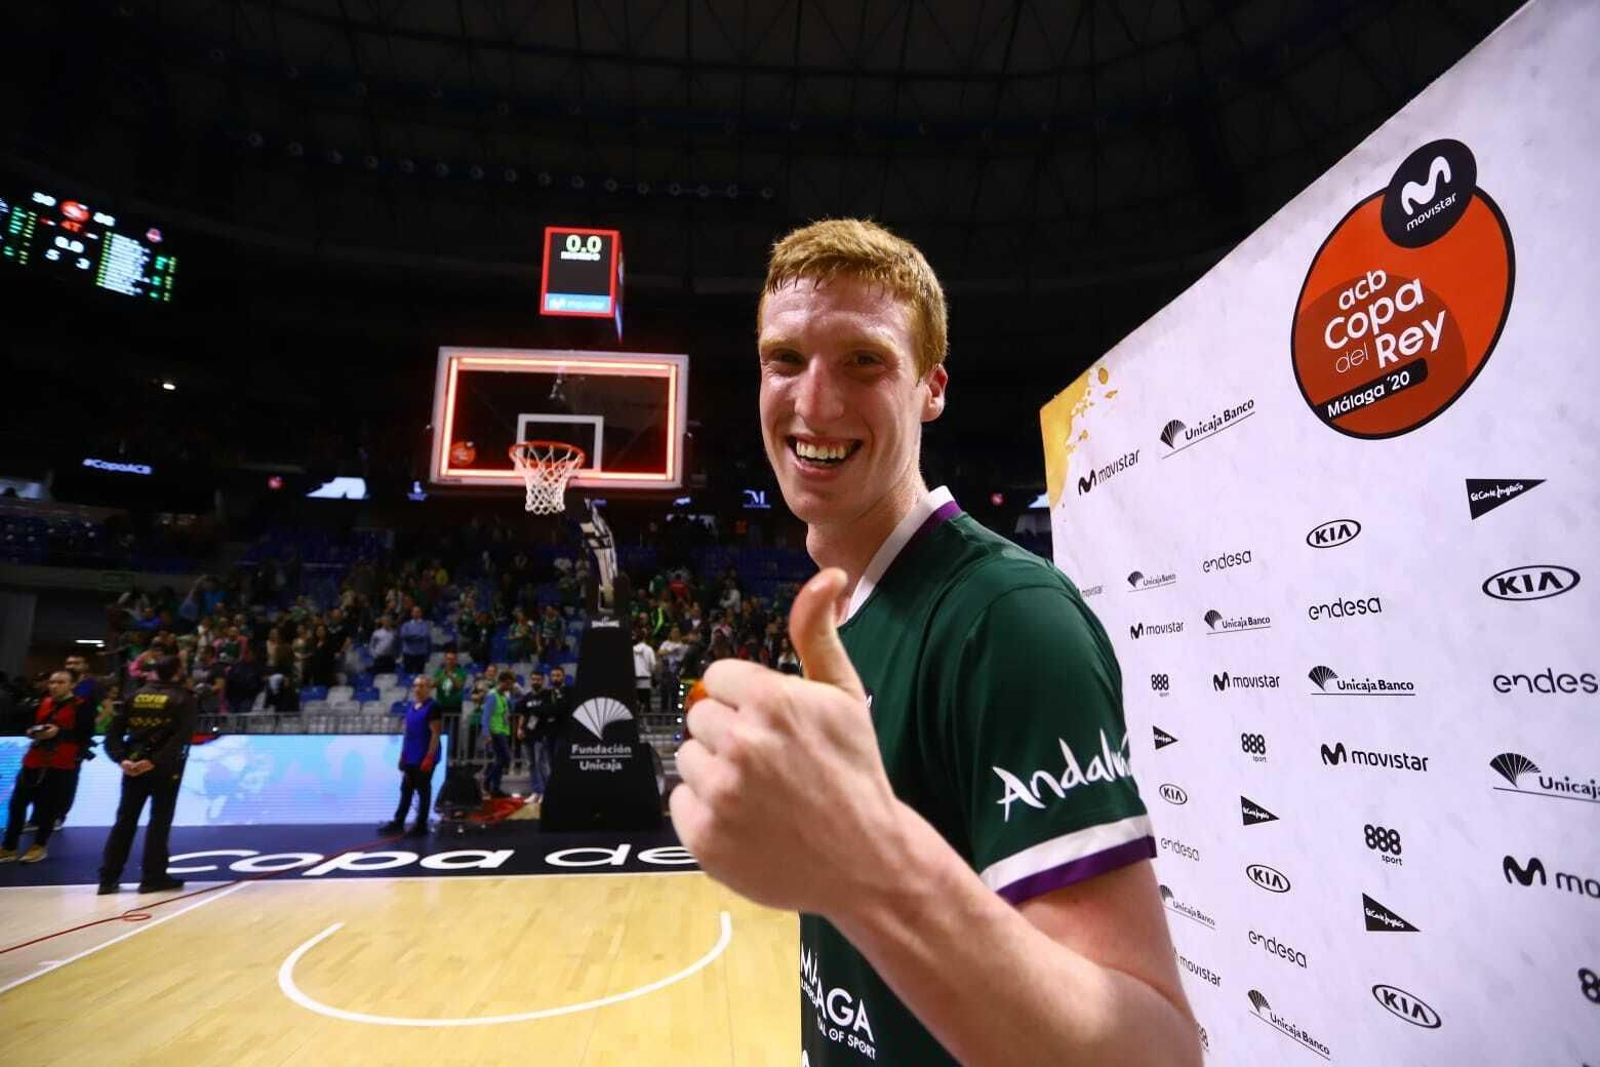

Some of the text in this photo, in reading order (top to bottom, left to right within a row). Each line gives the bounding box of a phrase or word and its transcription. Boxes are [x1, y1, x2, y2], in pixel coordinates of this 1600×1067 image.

[1405, 192, 1458, 231] movistar
[565, 234, 603, 253] 0.0
[1338, 269, 1387, 311] acb
[1335, 310, 1446, 374] del Rey
[1326, 383, 1386, 419] Málaga
[1184, 398, 1255, 442] Unicaja Banco
[1098, 449, 1140, 484] movistar
[1314, 524, 1352, 545] KIA
[1202, 549, 1252, 573] endesa
[1143, 572, 1177, 587] Unicaja Banco
[1496, 571, 1565, 596] KIA
[1308, 596, 1383, 621] endesa
[1145, 620, 1184, 636] movistar
[1221, 615, 1271, 630] Unicaja Banco
[1151, 673, 1169, 691] 888
[1232, 674, 1281, 690] movistar
[1336, 678, 1415, 693] Unicaja Banco
[1492, 667, 1599, 694] endes
[571, 743, 632, 755] Fundación
[1241, 733, 1266, 755] 888
[579, 758, 623, 773] Unicaja
[1351, 749, 1429, 772] movistar
[1163, 787, 1184, 802] KIA
[1160, 837, 1200, 861] endesa
[1363, 824, 1402, 855] 888
[1381, 854, 1403, 867] sport
[1252, 867, 1284, 889] KIA
[1172, 900, 1216, 926] Unicaja Banco
[1248, 930, 1308, 969] endesa
[1179, 955, 1221, 987] movistar
[1577, 967, 1600, 1005] 8
[1382, 989, 1431, 1024] KIA
[828, 1027, 877, 1060] OF SPORT
[1269, 1011, 1331, 1056] Unicaja Banco
